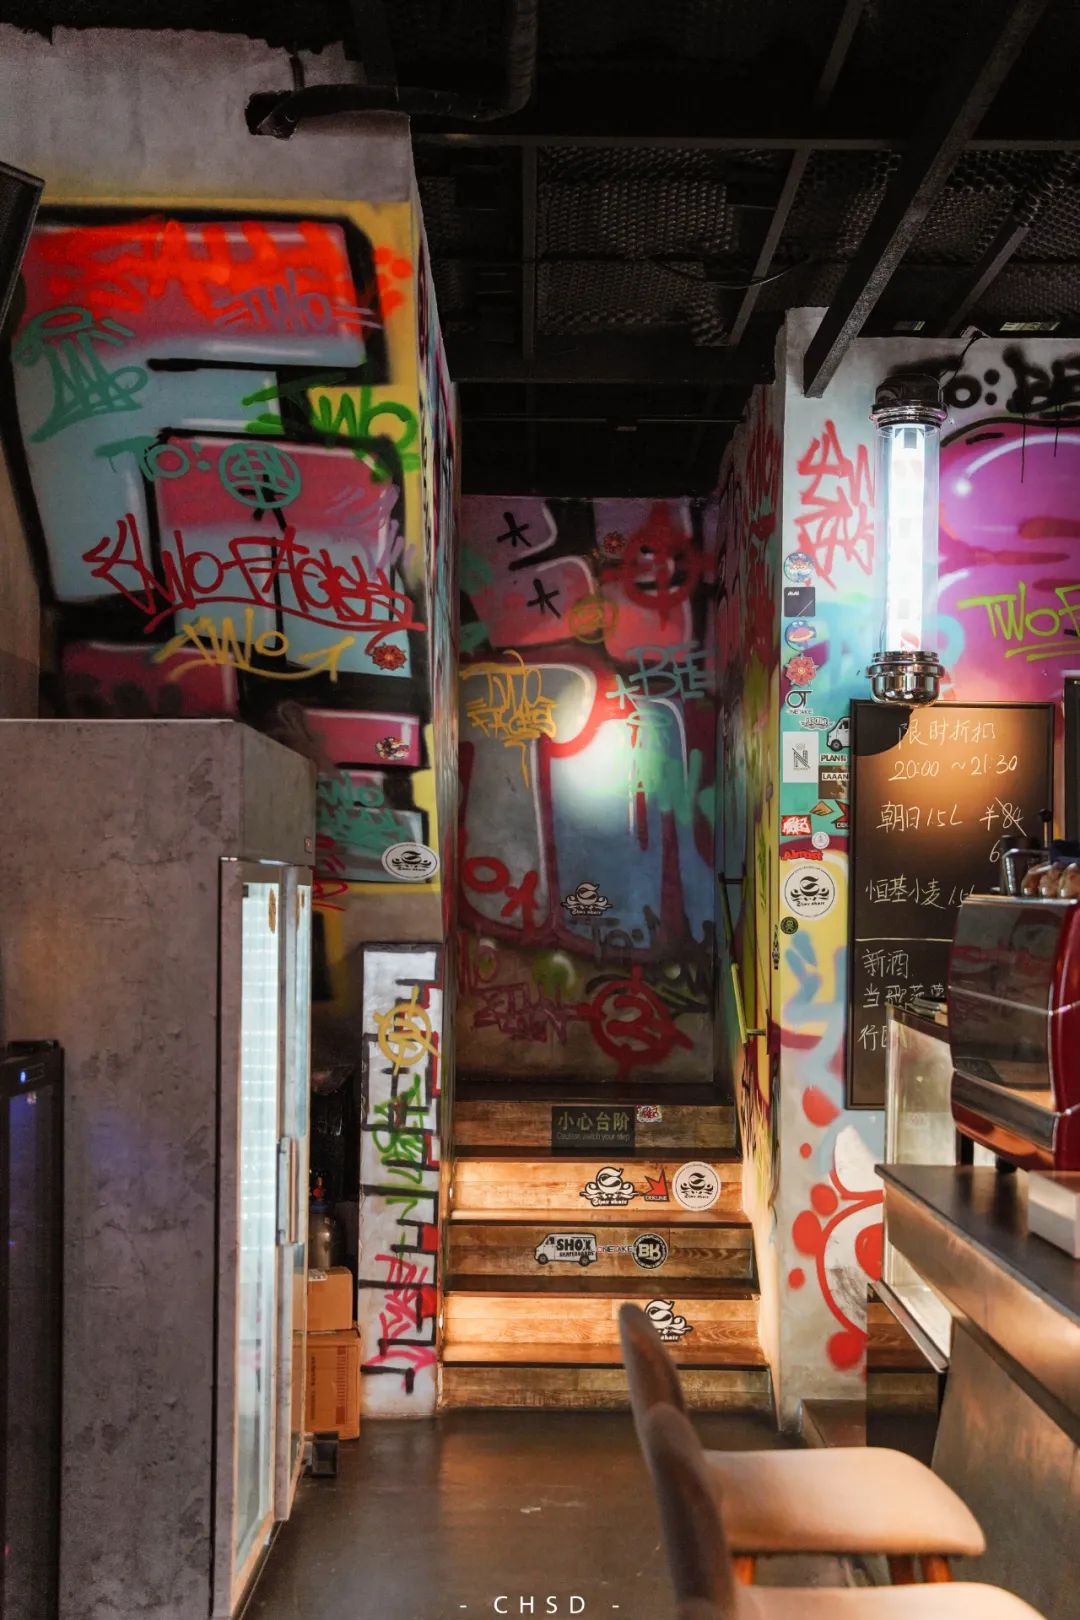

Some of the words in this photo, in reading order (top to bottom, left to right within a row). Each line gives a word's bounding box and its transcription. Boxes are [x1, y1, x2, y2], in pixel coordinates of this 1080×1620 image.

[897, 719, 996, 749] 限时折扣
[558, 1111, 630, 1131] 小心台阶
[556, 1238, 592, 1251] SHOX
